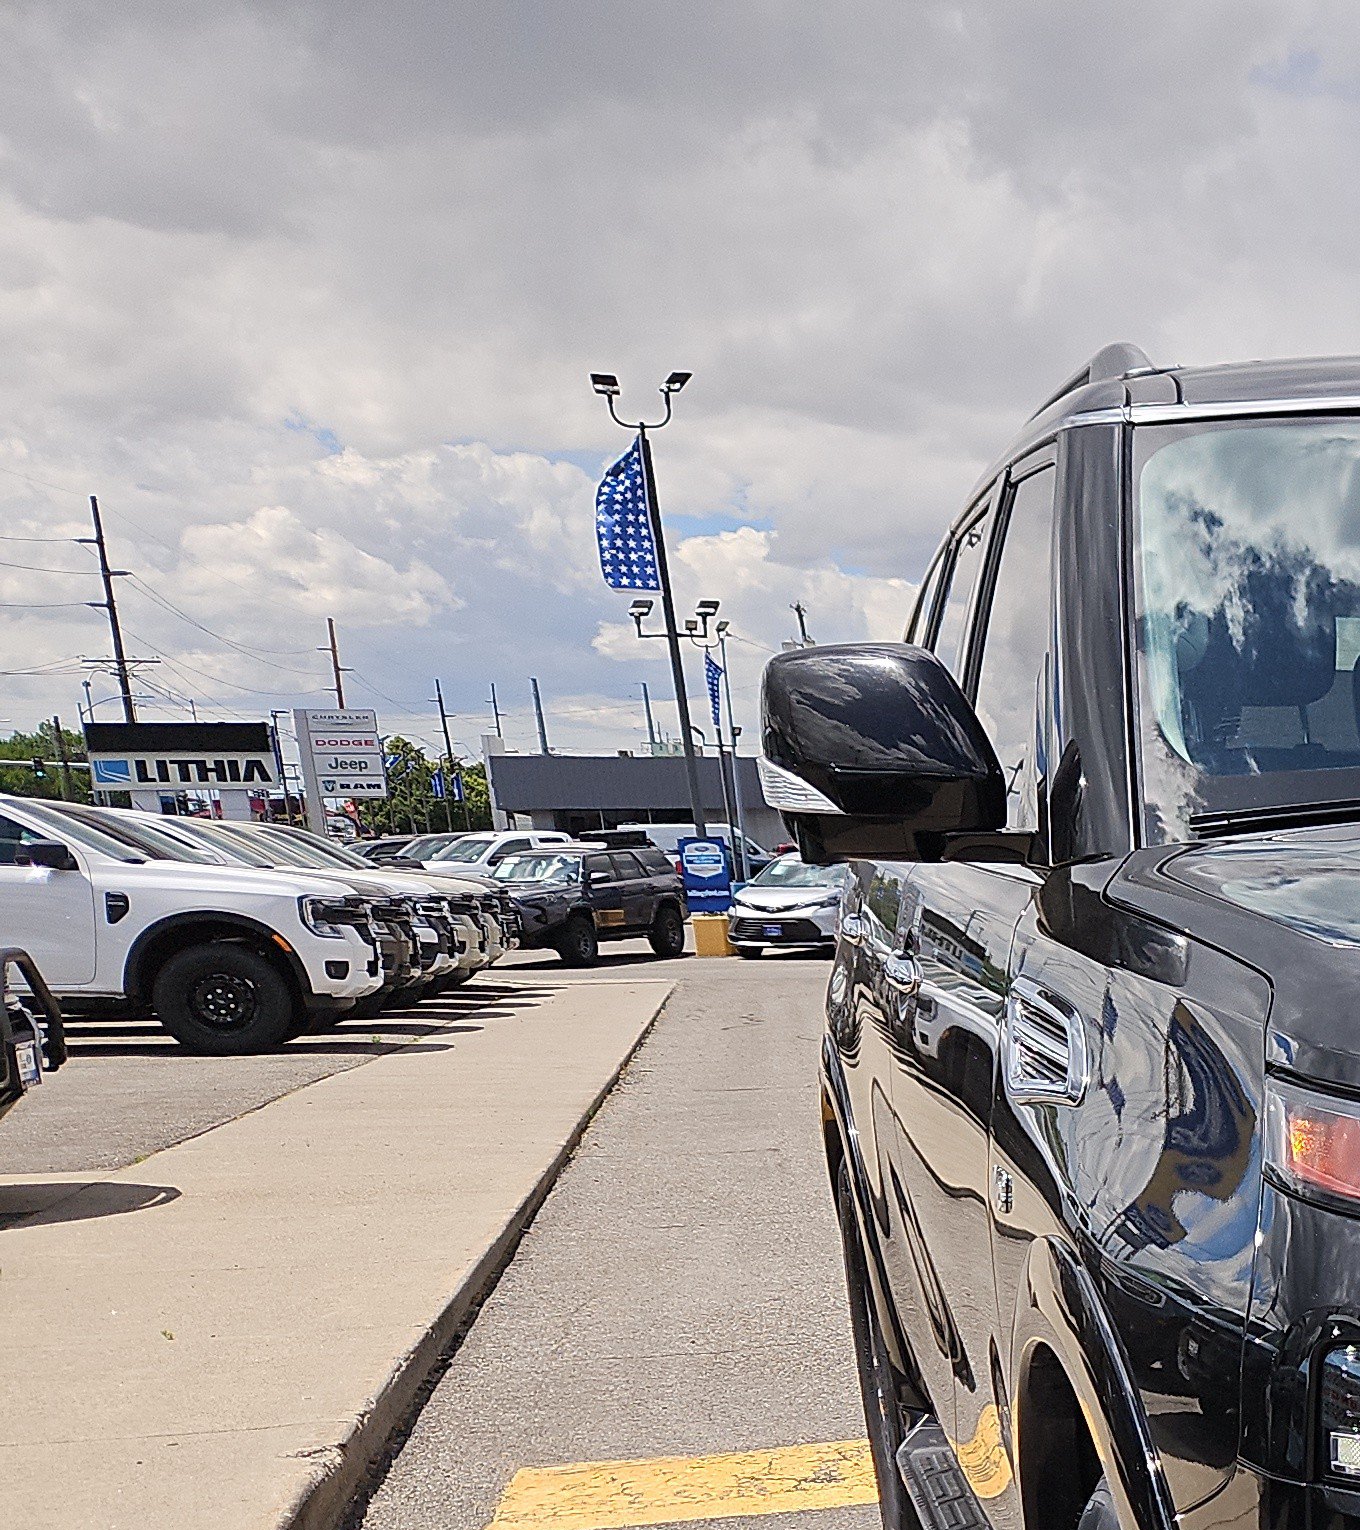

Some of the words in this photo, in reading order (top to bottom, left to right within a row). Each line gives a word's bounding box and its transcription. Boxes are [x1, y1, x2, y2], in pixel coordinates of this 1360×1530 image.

[315, 739, 375, 747] DODGE
[134, 759, 273, 783] LITHIA
[328, 757, 368, 772] Jeep
